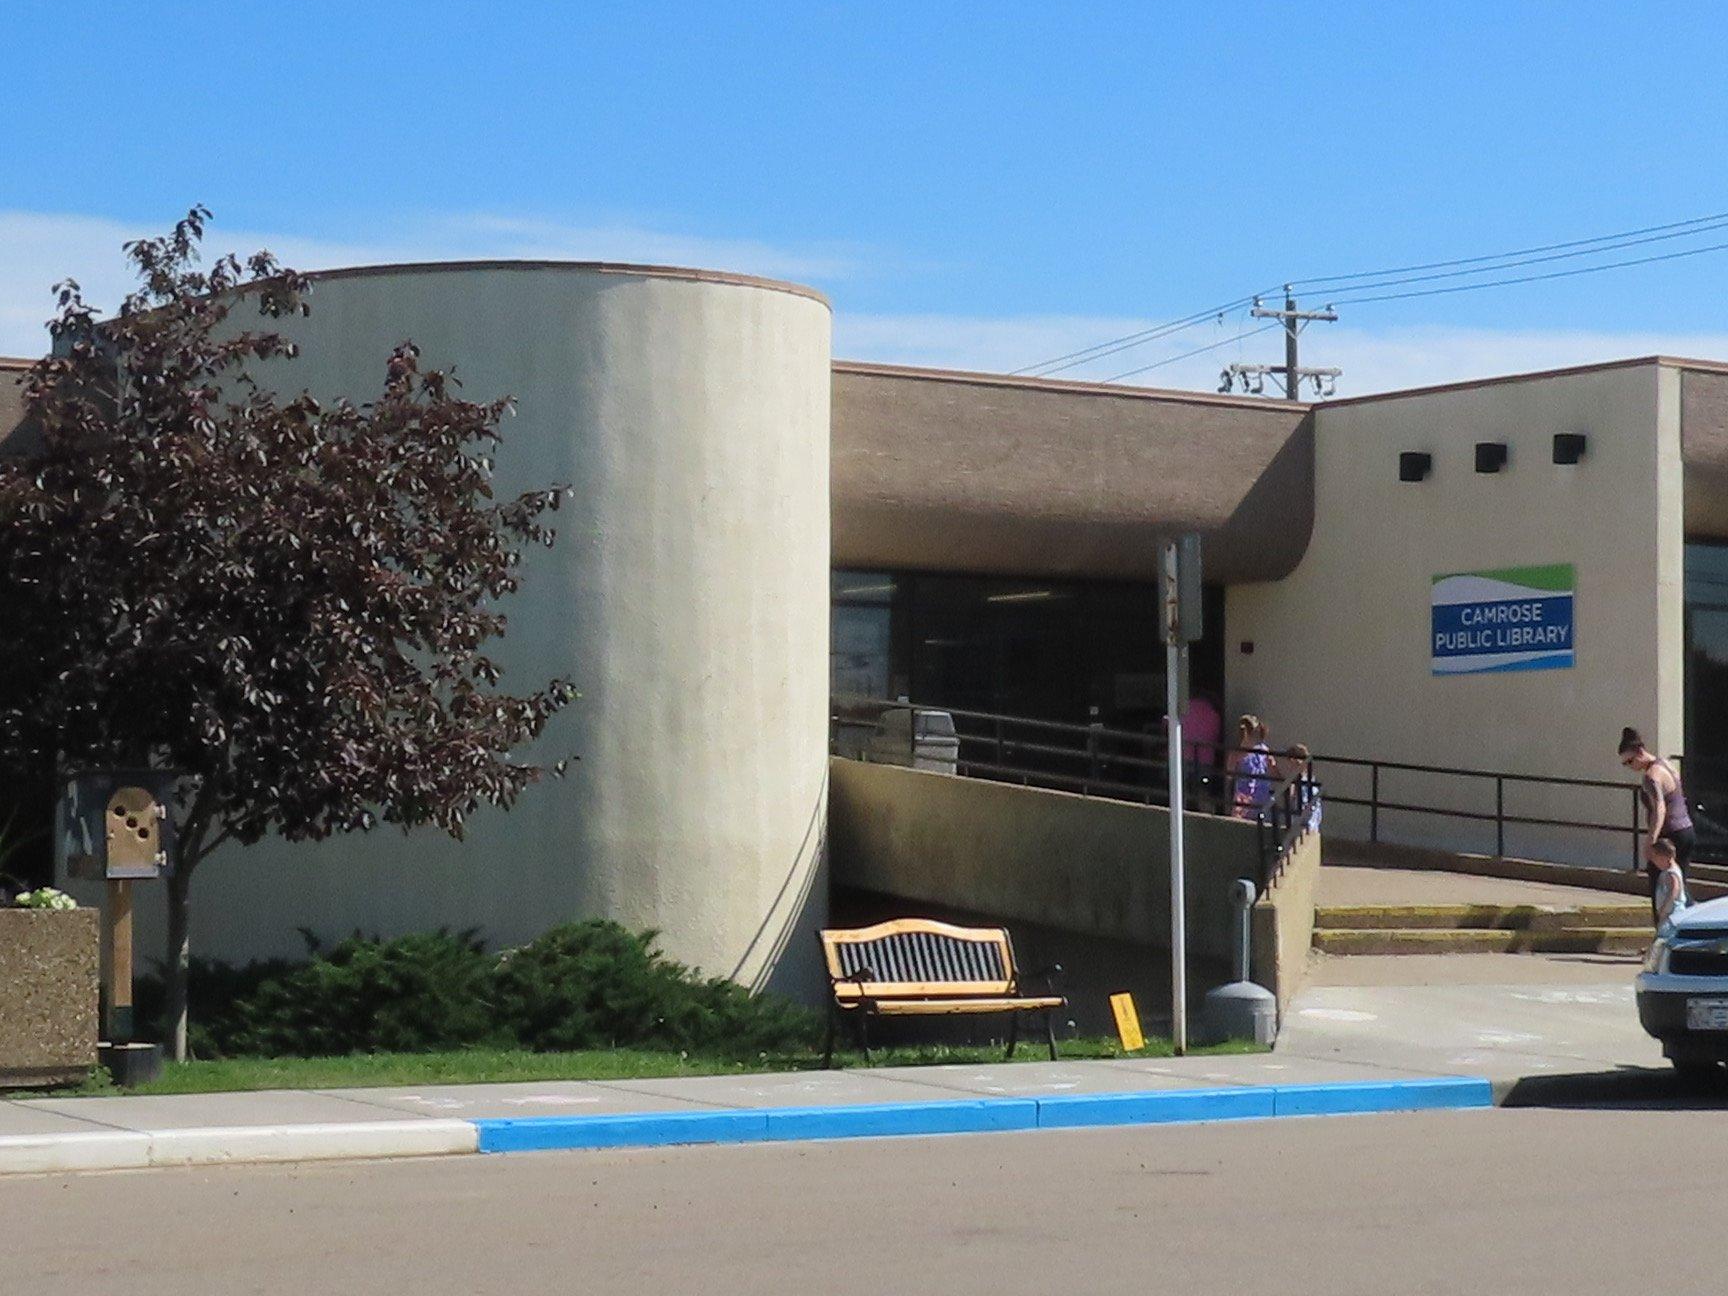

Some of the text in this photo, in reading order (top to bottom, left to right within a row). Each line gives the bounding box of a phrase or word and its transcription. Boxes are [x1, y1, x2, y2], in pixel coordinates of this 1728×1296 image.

[1461, 603, 1542, 625] CAMROSE
[1435, 624, 1569, 650] PUBLIC LIBRARY
